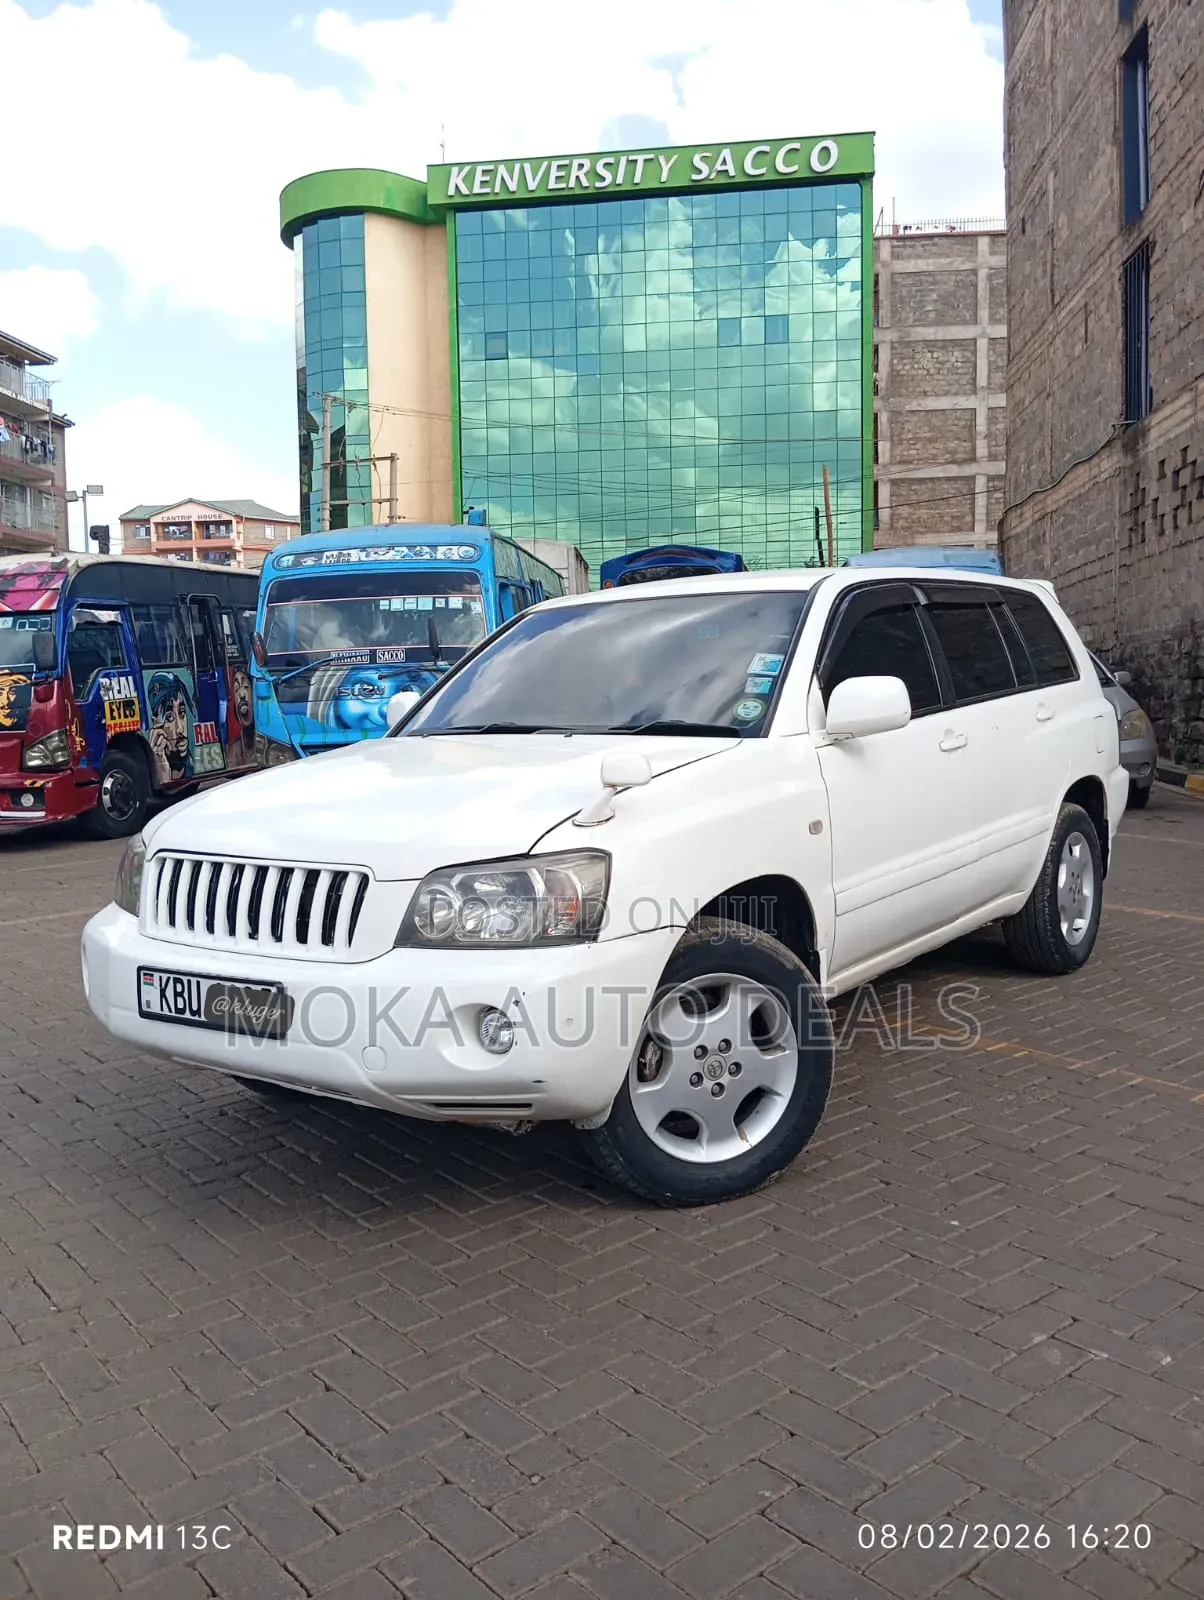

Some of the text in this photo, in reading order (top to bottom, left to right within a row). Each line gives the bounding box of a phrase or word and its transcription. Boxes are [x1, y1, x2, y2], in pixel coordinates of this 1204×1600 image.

[447, 139, 839, 197] KENVERSITY SACCO
[378, 650, 404, 662] SACCO
[335, 684, 386, 697] ISUZU
[158, 975, 203, 1018] KBU
